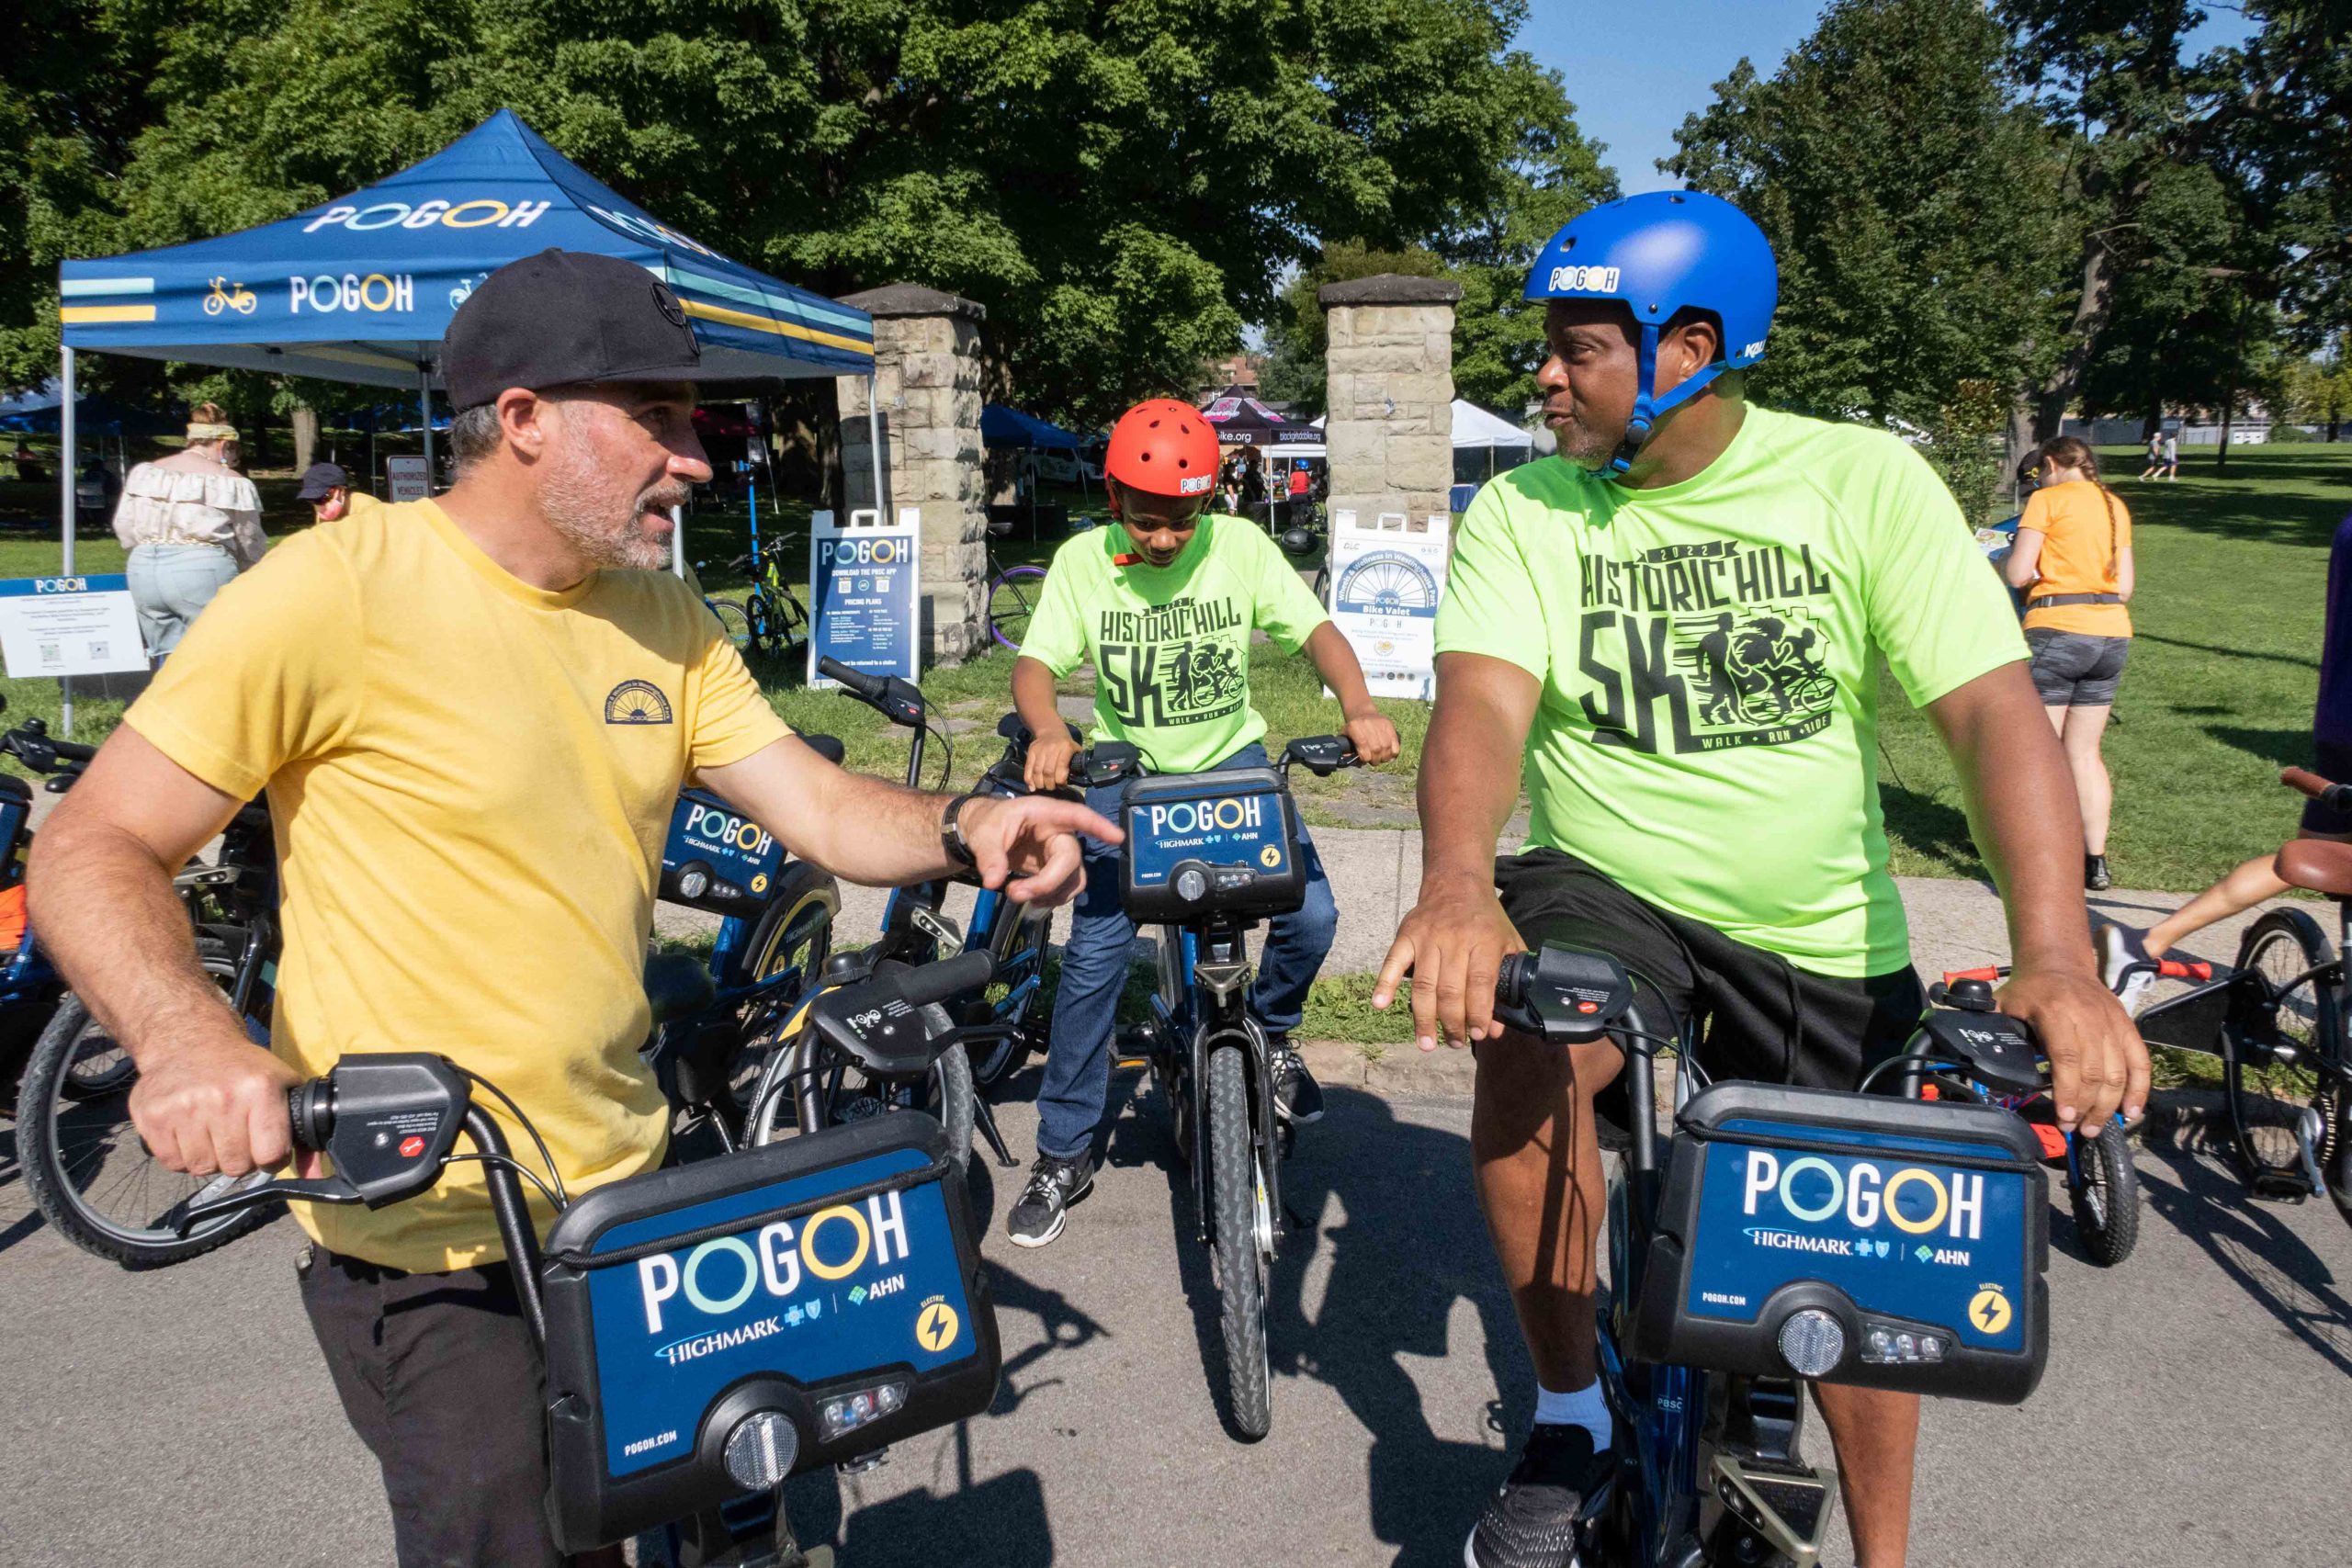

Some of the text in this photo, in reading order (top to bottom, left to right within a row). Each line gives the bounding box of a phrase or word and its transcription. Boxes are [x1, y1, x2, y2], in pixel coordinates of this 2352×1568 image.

[303, 199, 551, 233] POGOH
[289, 273, 413, 313] POGOH
[1551, 268, 1617, 290] POGOH
[821, 538, 909, 566] POGOH
[1660, 545, 1708, 561] 2022
[35, 578, 87, 593] POGOH
[831, 569, 860, 577] DOWNLOAD
[1352, 553, 1384, 570] Wellness
[1394, 553, 1433, 589] Westinghouse
[1580, 543, 1831, 613] HISTORIC HILL
[1100, 596, 1242, 643] HISTORIC HILL
[1363, 604, 1410, 616] Bike Valet
[1369, 618, 1402, 628] PGH
[1099, 644, 1164, 728] 5K
[1578, 611, 1691, 754] 5K
[1169, 716, 1191, 726] WALK
[1204, 711, 1218, 720] RUN
[1702, 717, 1828, 749] WALK RUN RIDE
[684, 804, 773, 856] POGOH
[1151, 796, 1261, 836] POGOH
[684, 836, 761, 865] HIGHMARK AHN
[1159, 832, 1258, 849] HIGHMARK AHN
[1744, 1150, 1984, 1240] POGOH
[638, 1190, 910, 1334] POGOH
[1751, 1229, 1970, 1267] HIGHMARK AHN
[920, 1294, 945, 1309] ELECTRIC
[1702, 1292, 1747, 1305] POGOH.COM
[1978, 1282, 2004, 1292] ELECTRIC
[668, 1273, 906, 1365] HIGHMARK AHN
[1657, 1397, 1683, 1410] PBSC
[625, 1429, 677, 1457] POGOH.COM
